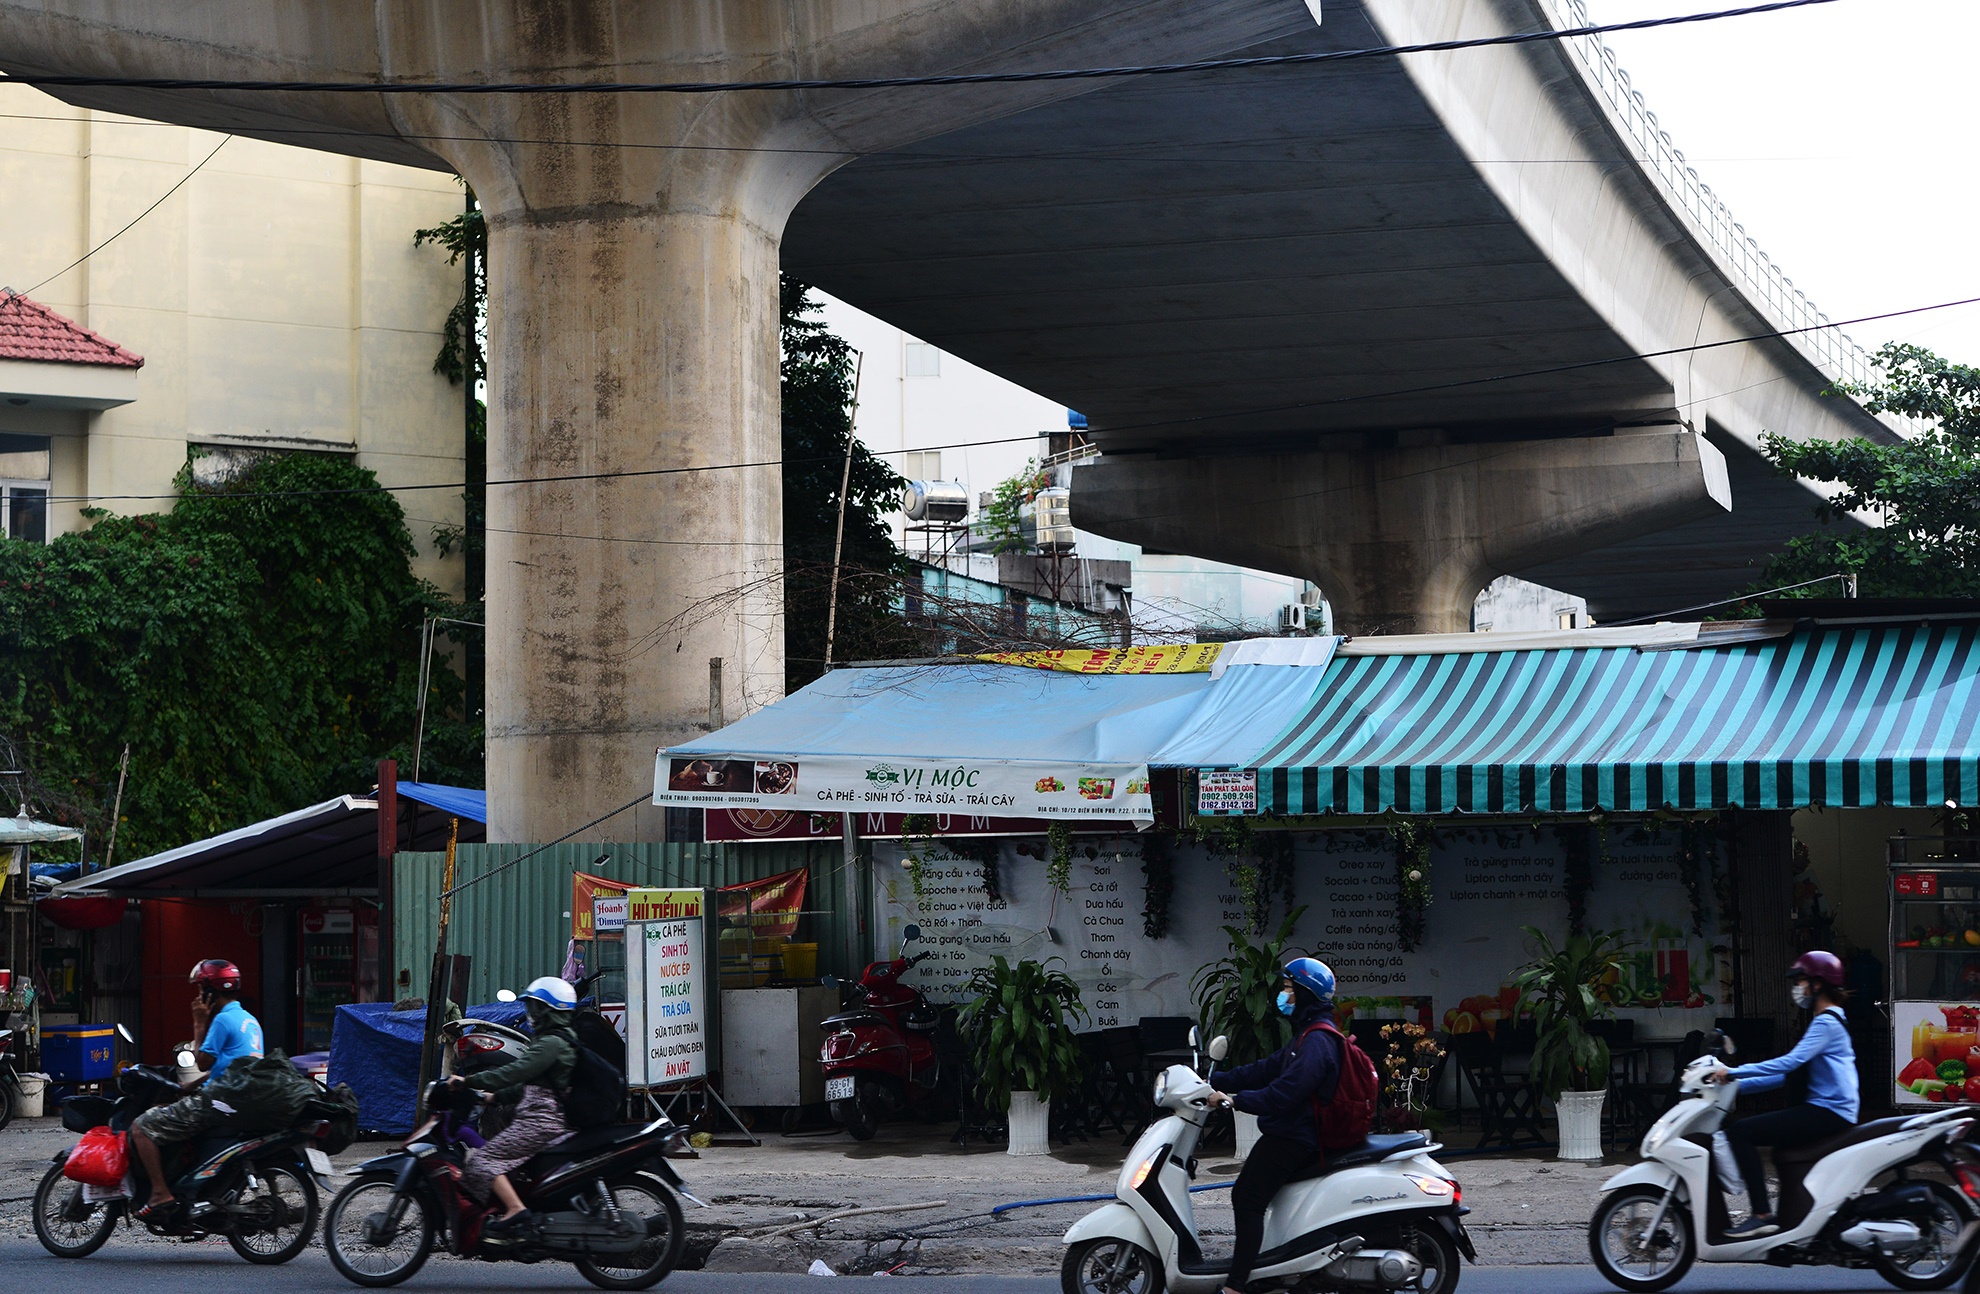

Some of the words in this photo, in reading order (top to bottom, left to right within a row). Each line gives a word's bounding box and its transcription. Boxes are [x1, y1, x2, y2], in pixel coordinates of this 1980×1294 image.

[903, 768, 923, 790] VỊ
[930, 764, 980, 790] MỘC
[818, 789, 833, 800] CÀ
[836, 789, 854, 801] PHÊ
[864, 792, 888, 802] SINH
[891, 789, 905, 802] TỐ
[914, 790, 932, 803] TRÀ
[936, 792, 956, 804] SỮA
[966, 793, 988, 805] TRÁI
[992, 792, 1016, 806] CÂY
[1339, 860, 1364, 869] Oreo
[1367, 860, 1385, 870] xay
[1464, 857, 1479, 867] Trà
[1482, 856, 1508, 868] gừng
[1511, 856, 1531, 868] mật
[1534, 858, 1554, 868] ong
[946, 866, 962, 878] cầu
[1094, 866, 1110, 875] Sơri
[1325, 876, 1359, 886] Socola
[1466, 874, 1495, 884] Lipton
[1499, 874, 1530, 882] chanh
[1534, 873, 1554, 883] dây
[923, 886, 957, 896] apoche
[1090, 882, 1103, 892] Cà
[1106, 881, 1118, 892] rốt
[1218, 894, 1236, 906] Việt
[1330, 892, 1364, 901] Cacao
[1377, 891, 1396, 901] Dừa
[1450, 890, 1480, 901] Lipton
[1483, 890, 1515, 899] chanh
[1528, 889, 1547, 900] mật
[633, 894, 649, 920] HỦ
[652, 892, 682, 919] TIẾU/
[685, 896, 699, 917] MÌ
[934, 902, 956, 910] chua
[966, 902, 984, 912] Việt
[987, 900, 1007, 912] quất
[1086, 900, 1103, 908] Dưa
[1106, 898, 1123, 908] hấu
[1224, 911, 1241, 922] Bạc
[1331, 908, 1346, 918] Trà
[1349, 909, 1373, 917] xanh
[1376, 910, 1395, 919] xay
[918, 918, 931, 927] Cà
[934, 917, 948, 927] Rốt
[958, 919, 982, 927] Thơm
[1084, 916, 1096, 925] Cà
[1099, 916, 1124, 925] Chua
[662, 922, 672, 938] CÀ
[673, 922, 686, 936] PHÊ
[1326, 925, 1352, 934] Coffe
[939, 937, 962, 945] gang
[973, 935, 990, 943] Dưa
[994, 932, 1010, 943] hấu
[1091, 934, 1114, 942] Thơm
[662, 944, 678, 958] SINH
[679, 940, 688, 956] TỐ
[1317, 941, 1344, 950] Coffe
[1347, 941, 1364, 950] sữa
[950, 950, 965, 960] Táo
[1080, 950, 1111, 958] Chanh
[1113, 950, 1131, 960] dây
[1359, 956, 1403, 968] nóng/đá
[660, 962, 681, 978] NƯỚC
[682, 961, 691, 976] ÉP
[920, 968, 932, 976] Mít
[944, 967, 961, 976] Dừa
[1102, 962, 1112, 975] Ổi
[1362, 972, 1406, 984] nóng/đá
[661, 982, 676, 998] TRÁI
[678, 980, 691, 996] CÂY
[920, 984, 931, 993] Bơ
[1097, 982, 1117, 992] Cóc
[662, 1002, 676, 1018] TRÀ
[677, 1000, 691, 1016] SỮA
[1096, 1000, 1119, 1009] Cam
[1098, 1016, 1118, 1025] Bưởi
[655, 1026, 668, 1039] SỮA
[668, 1025, 682, 1037] TƯƠI
[683, 1021, 699, 1035] TRÂN
[651, 1046, 668, 1059] CHÂU
[668, 1043, 690, 1056] ĐƯỜNG
[692, 1041, 704, 1052] ĐEN
[666, 1062, 676, 1077] ĂN
[677, 1059, 690, 1078] VẬT
